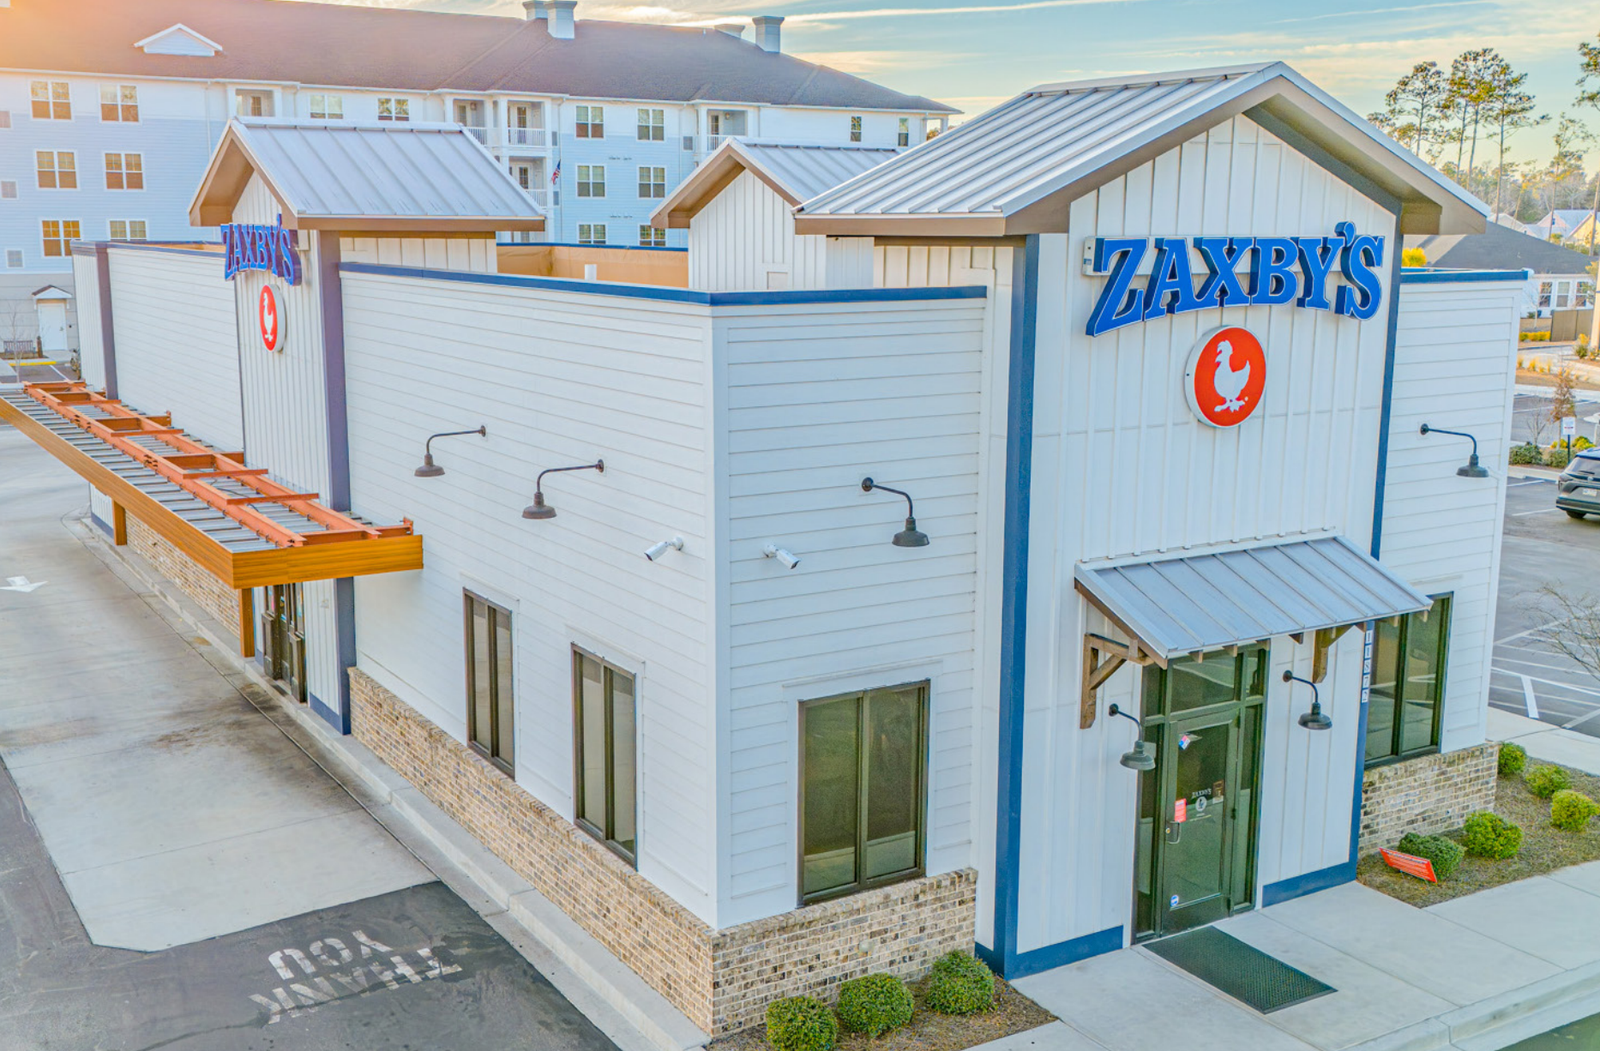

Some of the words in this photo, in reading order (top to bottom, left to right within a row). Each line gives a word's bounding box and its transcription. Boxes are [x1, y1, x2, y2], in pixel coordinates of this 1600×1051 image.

[220, 213, 302, 286] ZAXBY'S
[1086, 221, 1385, 336] ZAXBY'S
[268, 930, 393, 980] YOU
